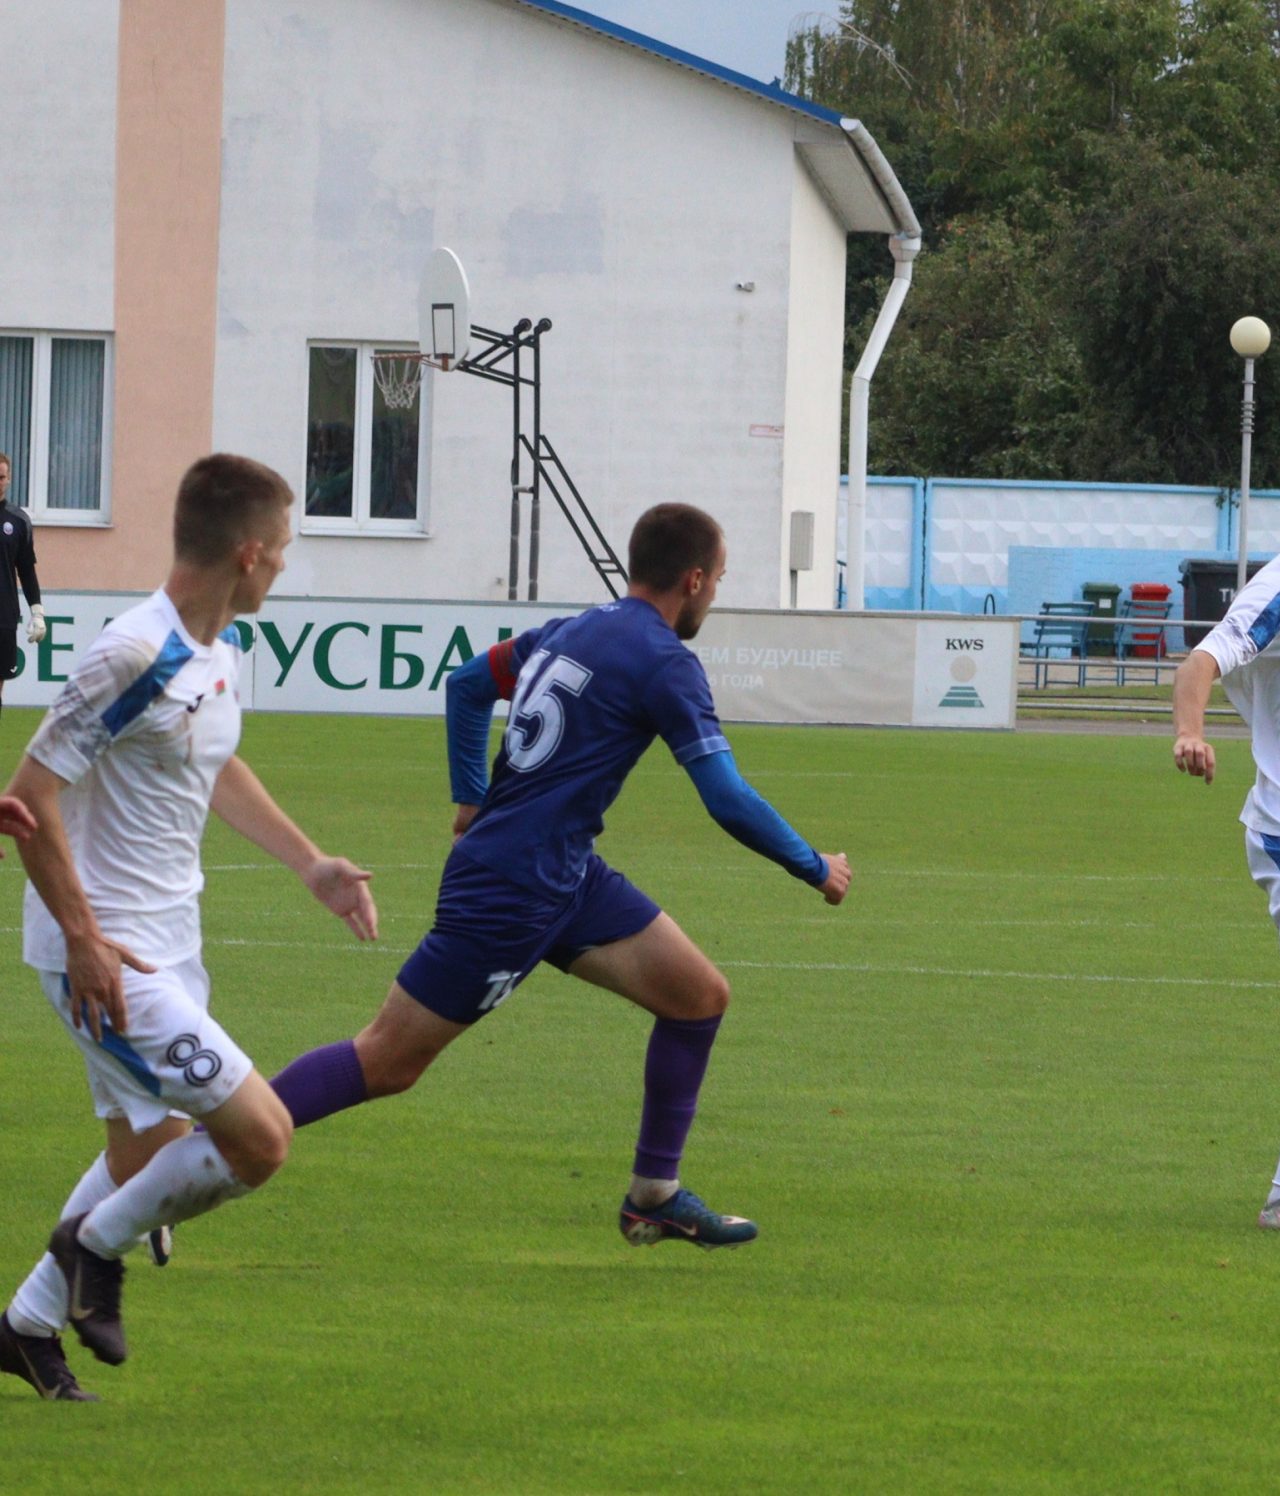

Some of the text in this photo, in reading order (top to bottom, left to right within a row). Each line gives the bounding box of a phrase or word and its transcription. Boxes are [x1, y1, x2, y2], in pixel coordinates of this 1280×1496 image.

[946, 639, 984, 650] KWS
[736, 647, 843, 669] БУДУЩЕЕ
[722, 674, 764, 689] ГОДА
[166, 1033, 222, 1088] 8
